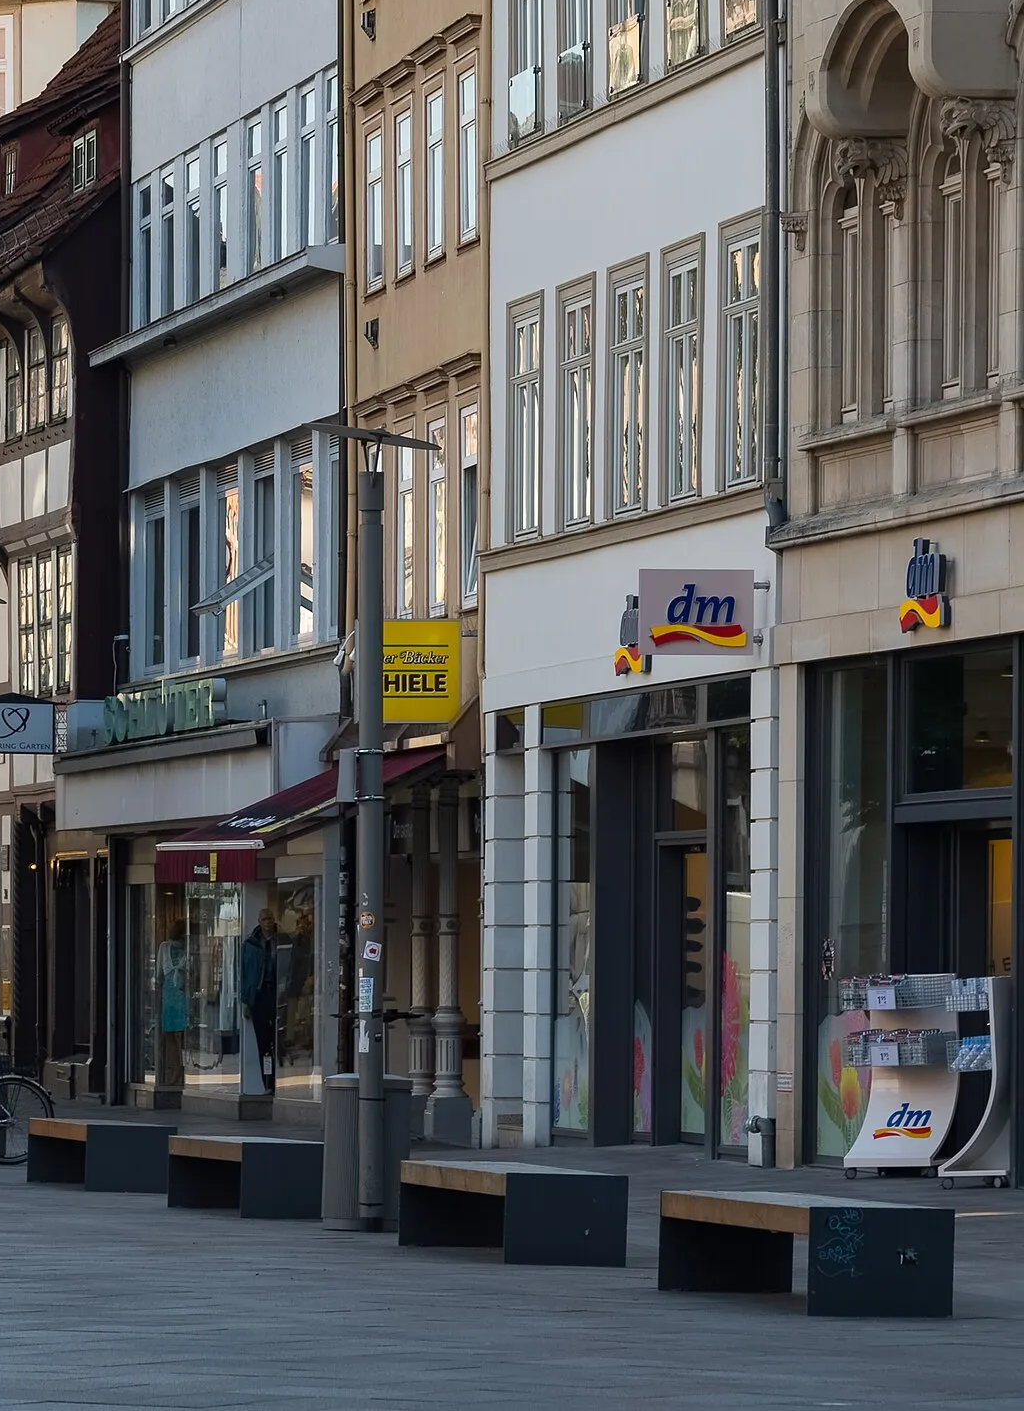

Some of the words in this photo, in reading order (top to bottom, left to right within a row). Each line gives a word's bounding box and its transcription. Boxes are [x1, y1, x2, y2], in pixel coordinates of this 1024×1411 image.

[907, 538, 938, 598] dm
[667, 584, 736, 625] dm
[400, 651, 449, 664] Bäcker
[384, 674, 446, 693] HIELE
[19, 741, 50, 750] GARTEN
[886, 1102, 933, 1128] dm
